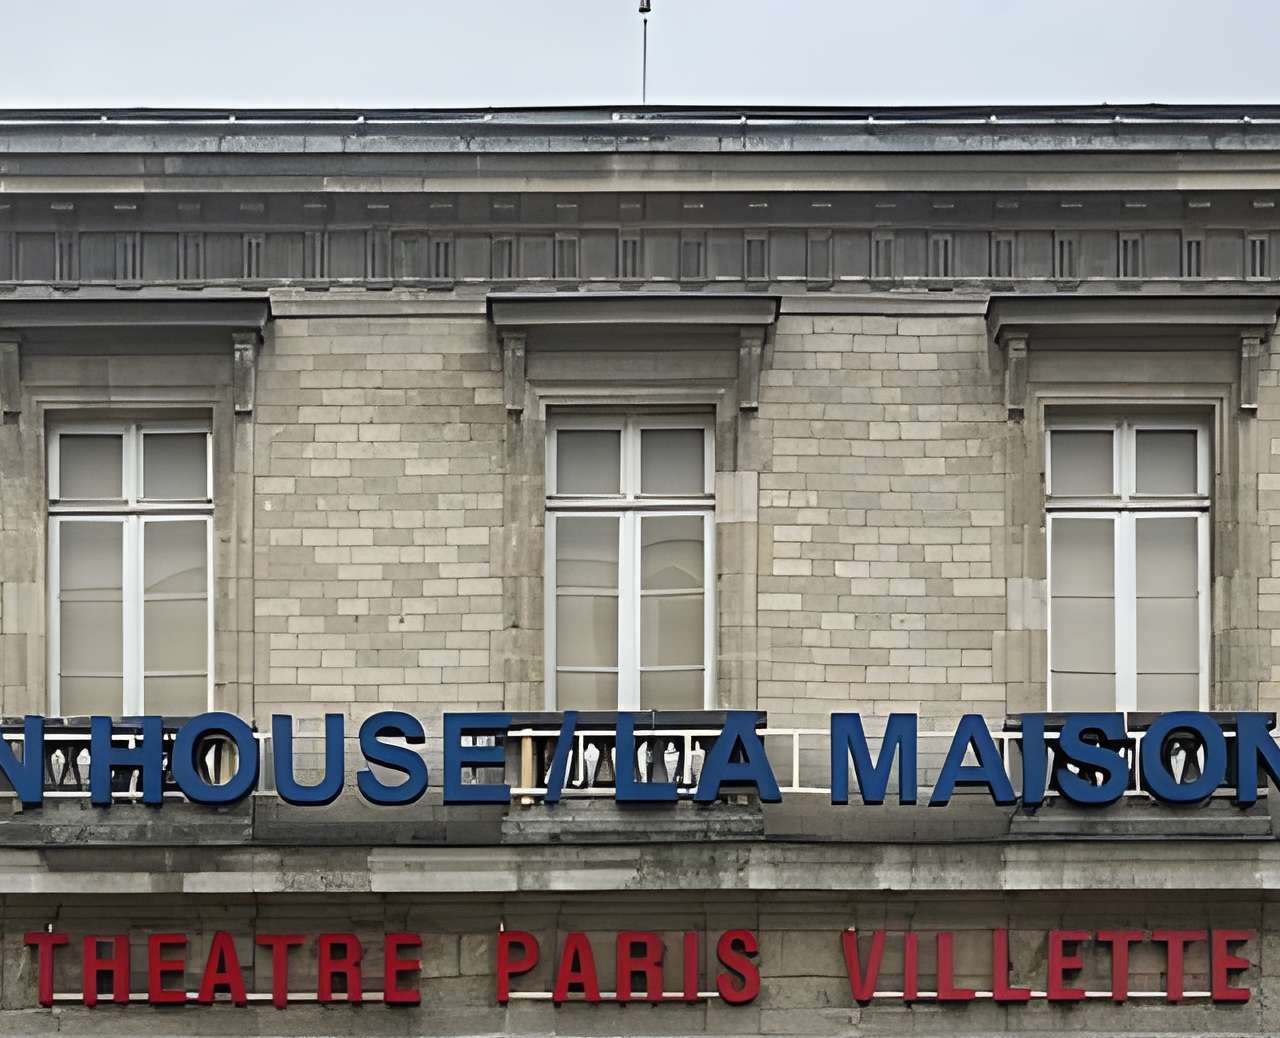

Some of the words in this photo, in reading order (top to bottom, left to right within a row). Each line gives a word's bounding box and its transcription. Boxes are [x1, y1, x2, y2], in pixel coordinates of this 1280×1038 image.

[91, 710, 512, 806] HOUSE
[614, 711, 783, 803] LA
[25, 932, 422, 1008] THEATRE
[498, 930, 761, 1006] PARIS
[842, 928, 1251, 1003] VILLETTE
